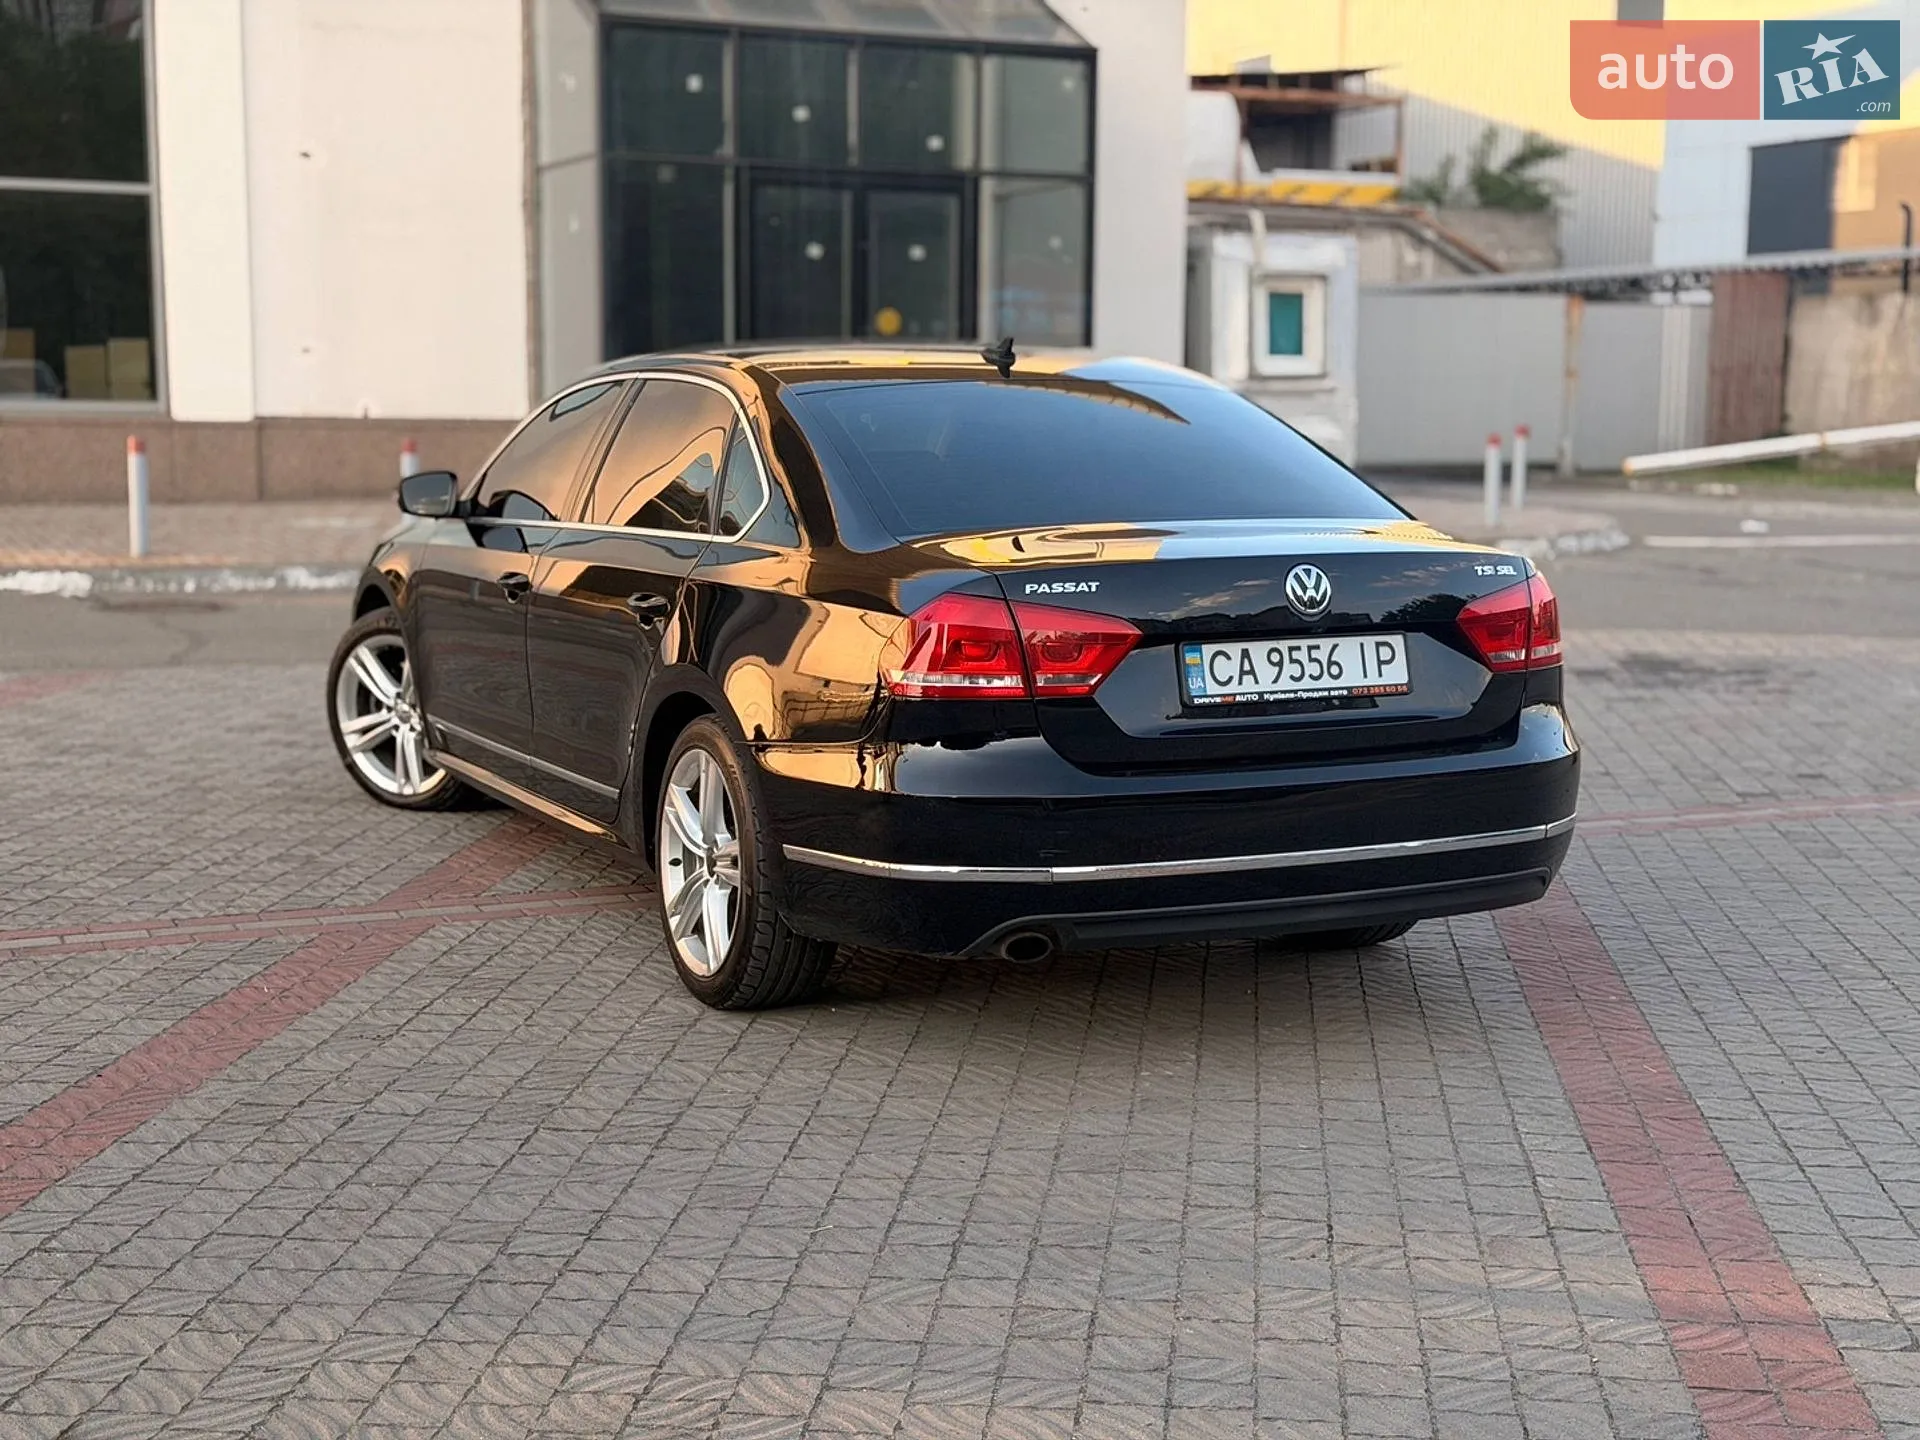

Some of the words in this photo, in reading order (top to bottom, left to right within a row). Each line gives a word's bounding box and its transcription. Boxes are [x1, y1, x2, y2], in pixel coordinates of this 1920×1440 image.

[1025, 582, 1100, 594] PASSAT
[1208, 648, 1259, 687] CA
[1265, 643, 1344, 684] 9556
[1359, 641, 1396, 679] IP
[1188, 677, 1204, 689] UA
[1235, 693, 1259, 702] AUTO
